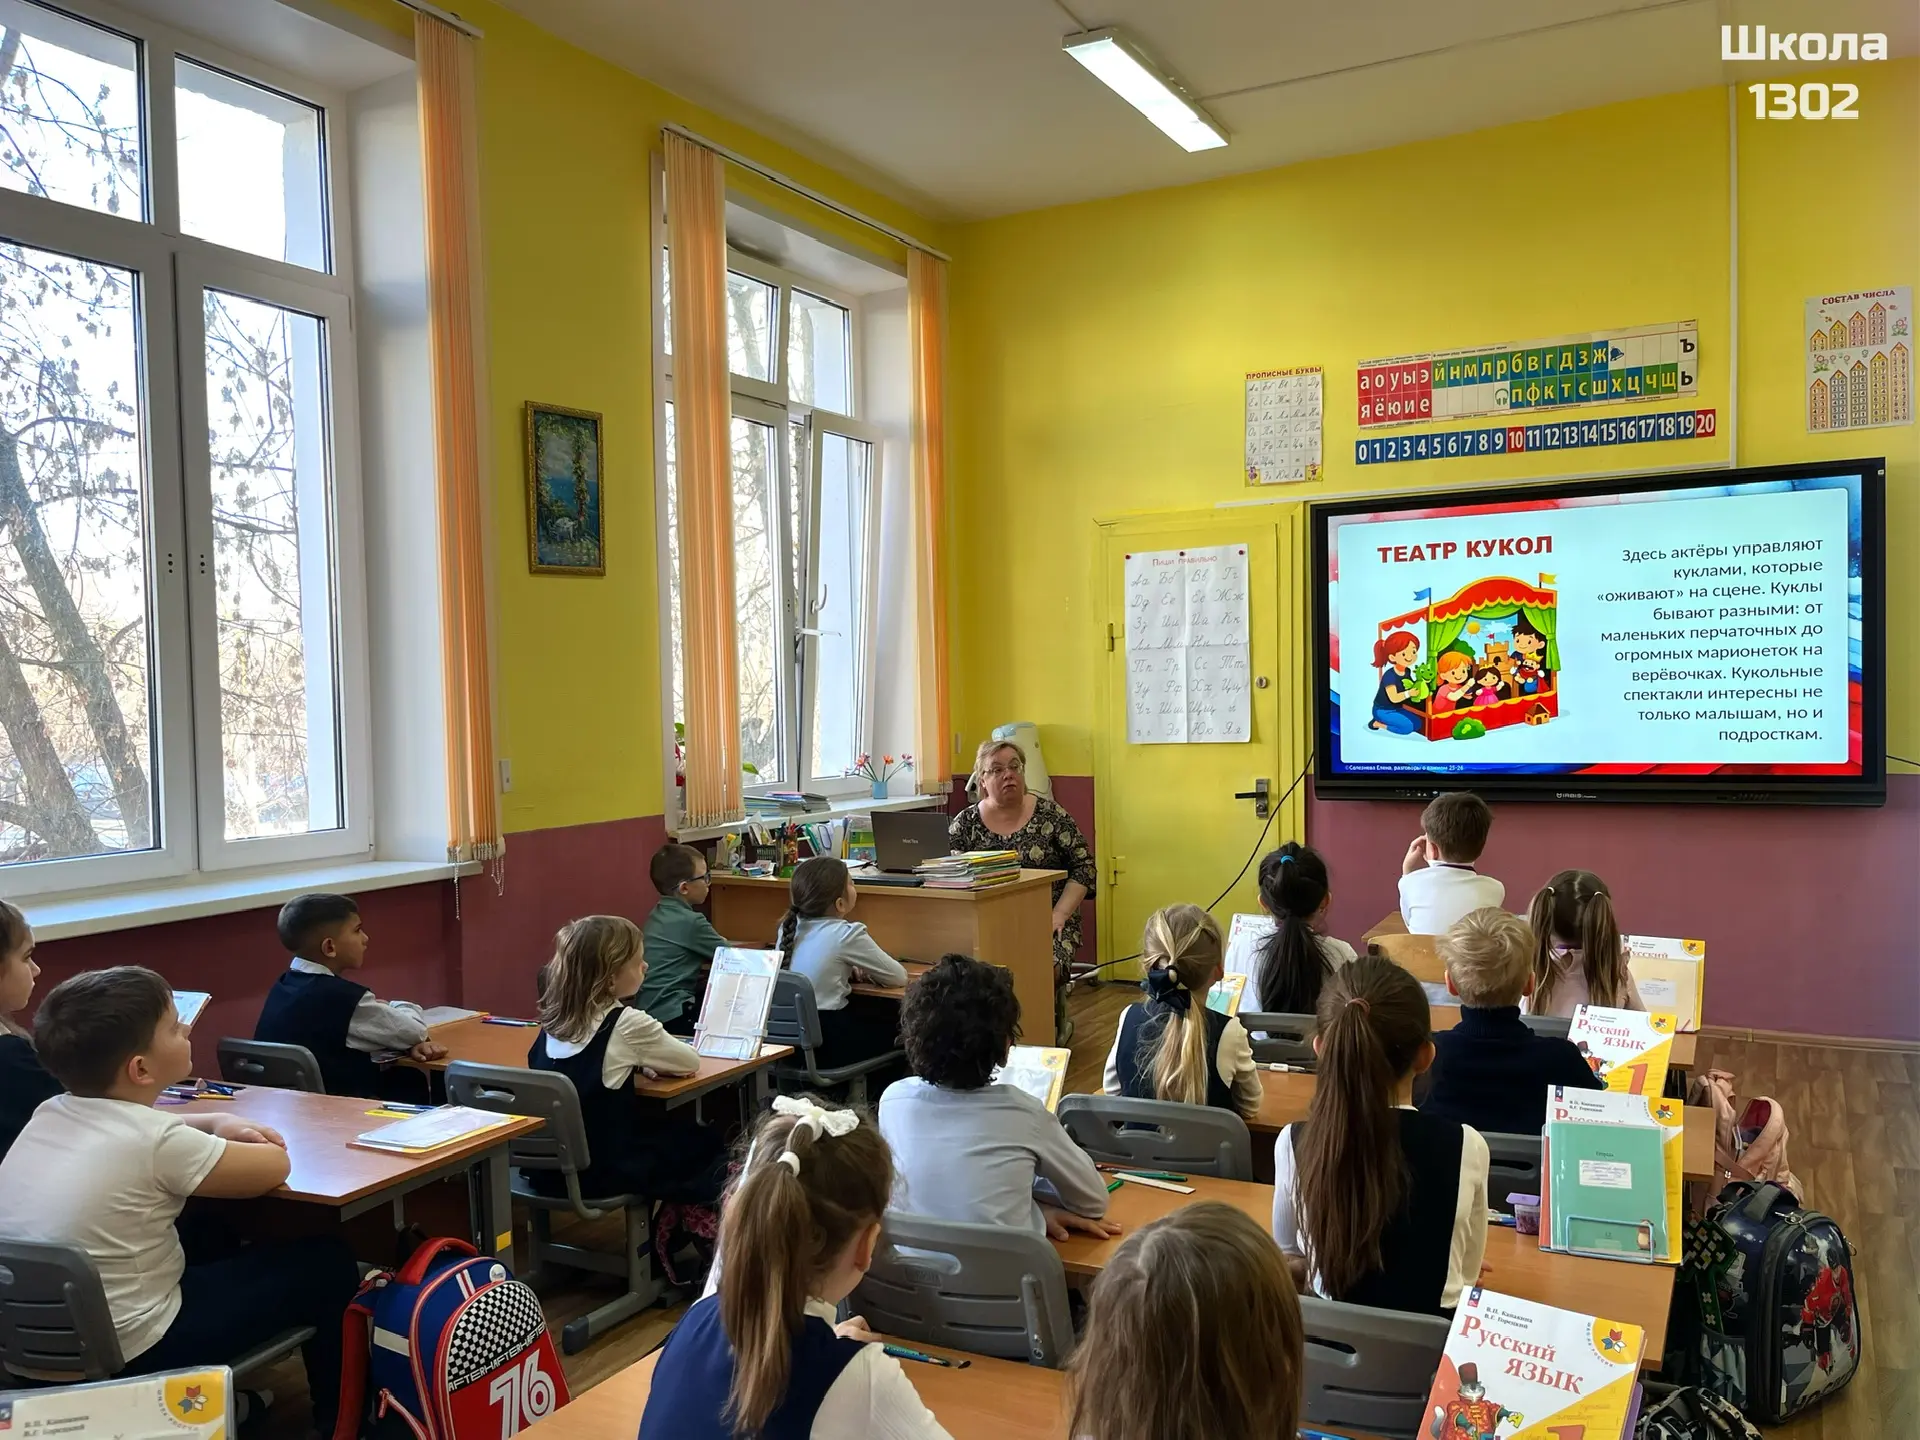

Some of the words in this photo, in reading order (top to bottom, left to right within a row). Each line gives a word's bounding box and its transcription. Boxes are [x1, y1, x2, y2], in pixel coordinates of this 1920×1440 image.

[1822, 294, 1860, 305] СОСТАВ
[1863, 290, 1896, 299] ЧИСЛА
[1246, 368, 1293, 380] ПРОПИСНЫЕ
[1295, 366, 1322, 375] БУКВЫ
[1360, 375, 1370, 390] а
[1375, 374, 1385, 388] о
[1390, 372, 1399, 391] у
[1403, 370, 1416, 385] ы
[1420, 369, 1429, 383] э
[1434, 362, 1445, 381] й
[1450, 365, 1460, 380] н
[1464, 363, 1477, 378] м
[1481, 362, 1492, 377] л
[1496, 359, 1507, 380] р
[1511, 352, 1523, 373] б
[1527, 355, 1538, 372] в
[1546, 354, 1555, 369] г
[1559, 352, 1573, 371] д
[1593, 348, 1607, 364] ж
[1361, 404, 1370, 419] я
[1375, 397, 1385, 417] ё
[1388, 401, 1401, 416] ю
[1404, 399, 1415, 414] и
[1420, 398, 1430, 413] е
[1511, 389, 1523, 403] п
[1527, 382, 1540, 406] ф
[1544, 384, 1555, 400] к
[1561, 383, 1572, 398] т
[1592, 379, 1607, 395] ш
[1611, 378, 1622, 393] х
[1627, 375, 1640, 394] ц
[1645, 373, 1657, 389] ч
[1661, 371, 1677, 390] щ
[1358, 443, 1367, 461] 0
[1373, 442, 1381, 460] 1
[1387, 441, 1396, 459] 2
[1402, 440, 1411, 457] 3
[1417, 438, 1427, 456] 4
[1432, 437, 1441, 455] 5
[1447, 436, 1457, 454] 6
[1463, 435, 1473, 452] 7
[1478, 433, 1488, 451] 8
[1494, 432, 1504, 450] 9
[1508, 430, 1523, 449] 10
[1526, 430, 1540, 447] 11
[1544, 427, 1560, 446] 12
[1563, 426, 1578, 445] 13
[1581, 424, 1598, 444] 14
[1601, 423, 1616, 442] 15
[1619, 421, 1636, 440] 16
[1638, 419, 1655, 438] 17
[1658, 417, 1674, 437] 18
[1677, 414, 1695, 435] 19
[1696, 413, 1715, 433] 20
[1377, 541, 1458, 564] ТЕАТР
[1466, 535, 1552, 558] КУКОЛ
[1622, 549, 1667, 563] Здесь
[1671, 543, 1728, 559] актёры
[1732, 539, 1824, 557] управляют
[1673, 565, 1747, 581] куклами,
[1752, 560, 1823, 575] которые
[1597, 588, 1684, 602] «оживают»
[1689, 587, 1708, 598] на
[1712, 584, 1766, 600] сцене.
[1770, 581, 1823, 597] Куклы
[1653, 606, 1715, 621] бывают
[1719, 603, 1799, 620] разными:
[1805, 602, 1823, 614] от
[1601, 628, 1685, 642] маленьких
[1690, 624, 1797, 641] перчаточных
[1801, 623, 1823, 638] до
[1614, 648, 1693, 663] огромных
[1697, 645, 1798, 661] марионеток
[1803, 645, 1823, 657] на
[1632, 668, 1727, 683] верёвочках.
[1731, 666, 1823, 681] Кукольные
[1623, 689, 1703, 701] спектакли
[1708, 687, 1797, 702] интересны
[1802, 687, 1823, 698] не
[1637, 709, 1691, 721] только
[1695, 708, 1782, 721] малышам,
[1786, 708, 1808, 719] но
[1812, 707, 1823, 718] и
[1718, 729, 1823, 743] подросткам.
[1577, 1018, 1631, 1037] Русский
[1627, 1063, 1649, 1096] 1
[1459, 1313, 1557, 1363] Русский
[489, 1348, 556, 1440] 76
